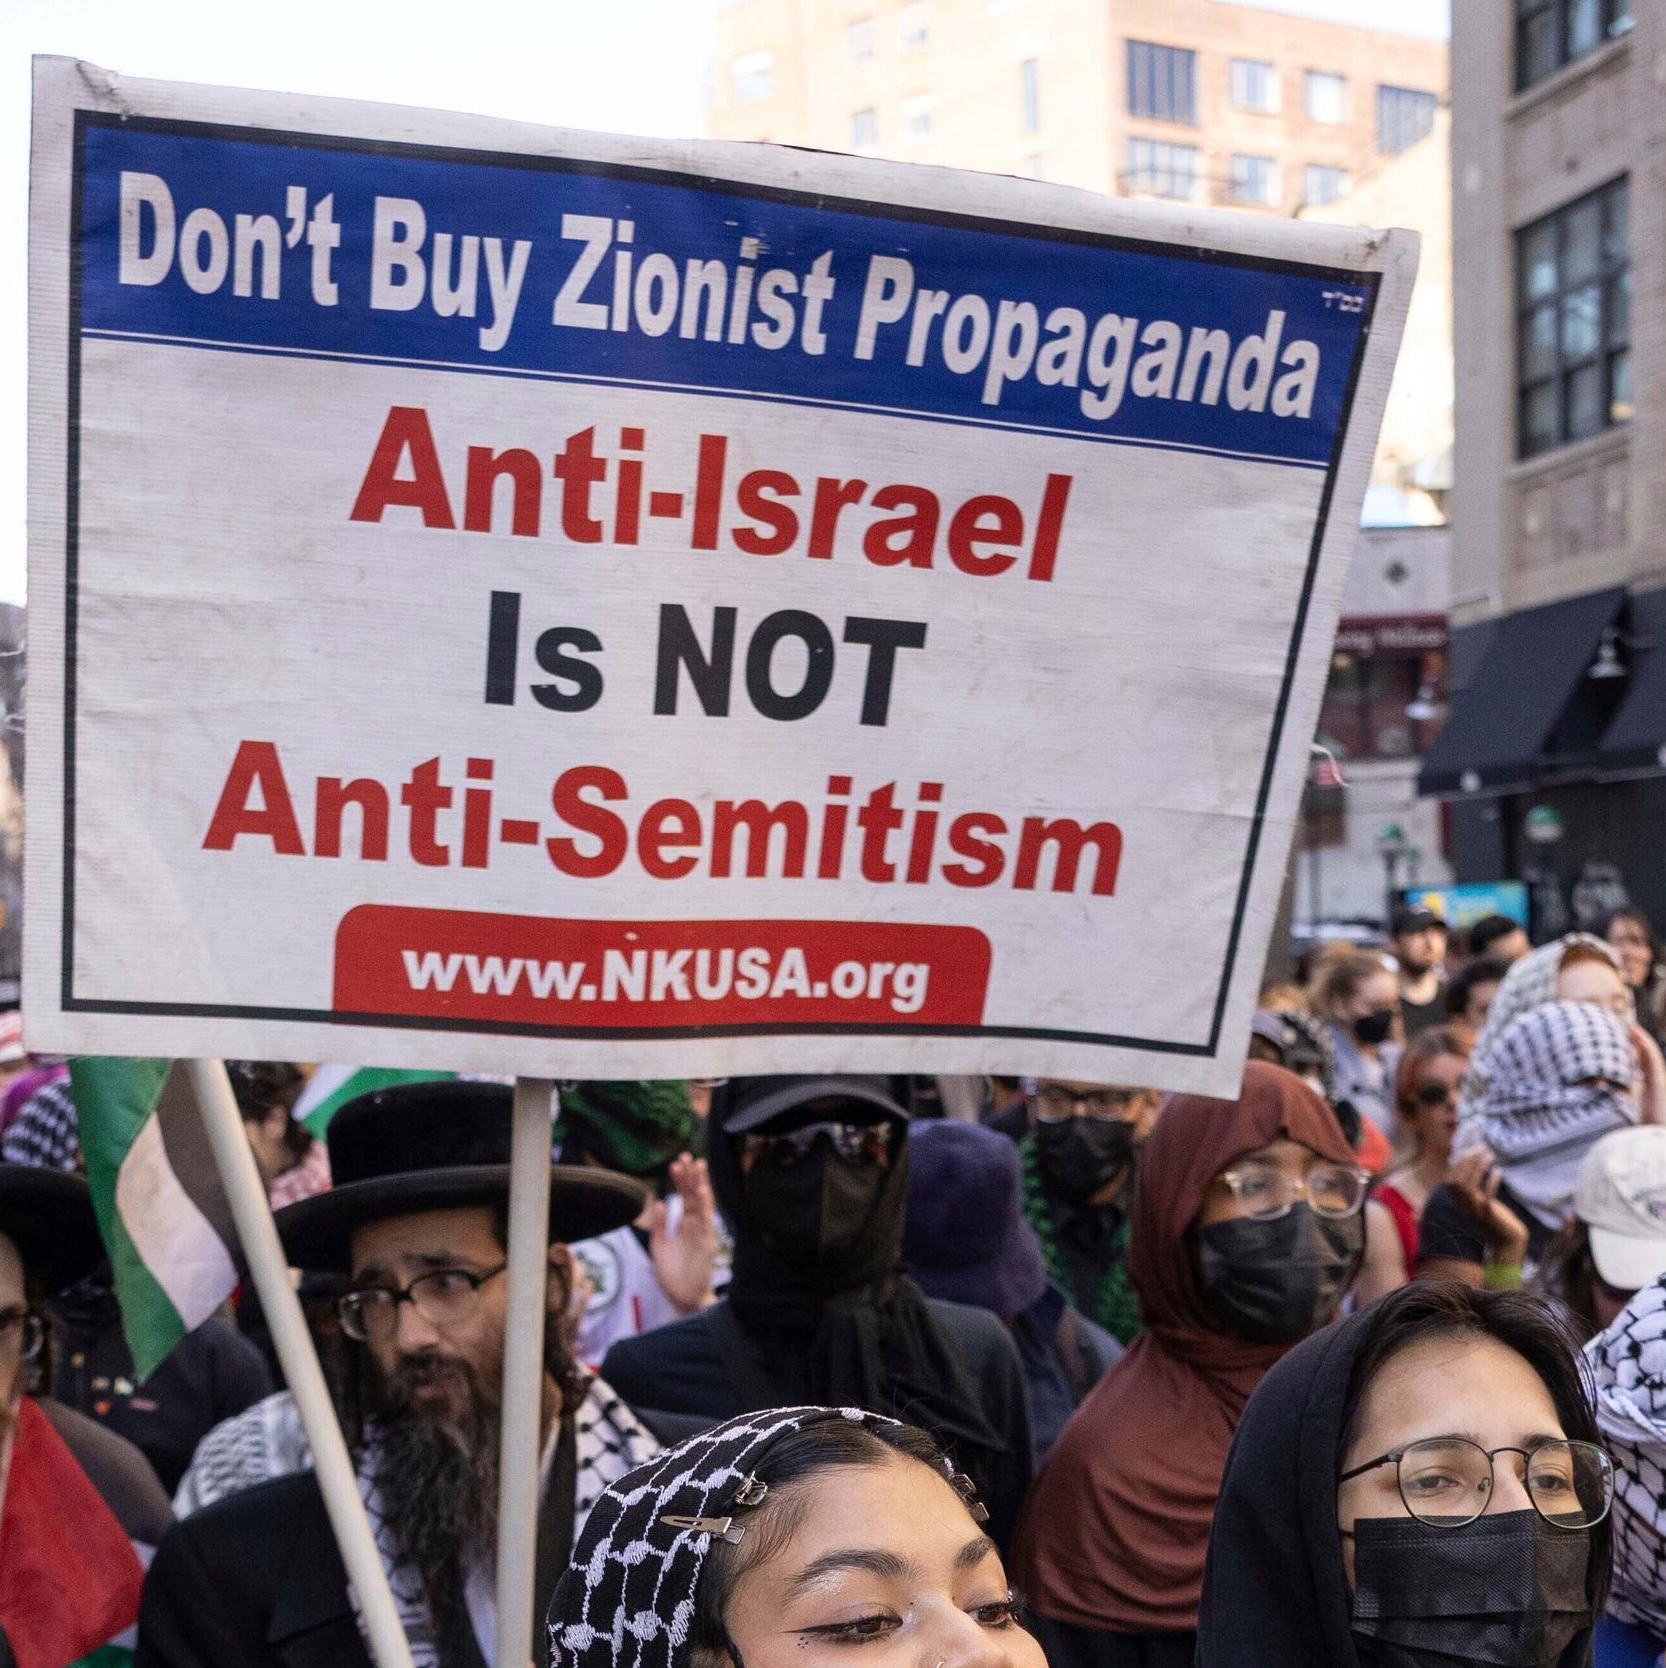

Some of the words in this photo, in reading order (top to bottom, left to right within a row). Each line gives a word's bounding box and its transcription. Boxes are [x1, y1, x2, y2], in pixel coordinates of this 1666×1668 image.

[119, 170, 341, 307] Don't
[370, 196, 533, 352] Buy
[552, 213, 835, 356] Zionist
[854, 255, 1320, 421] Propaganda
[351, 406, 1072, 581] Anti-Israel
[485, 590, 603, 713] Is
[654, 603, 928, 727] NOT
[204, 740, 1122, 896] Anti-Semitism
[401, 947, 930, 1006] www.NKUSA.org
